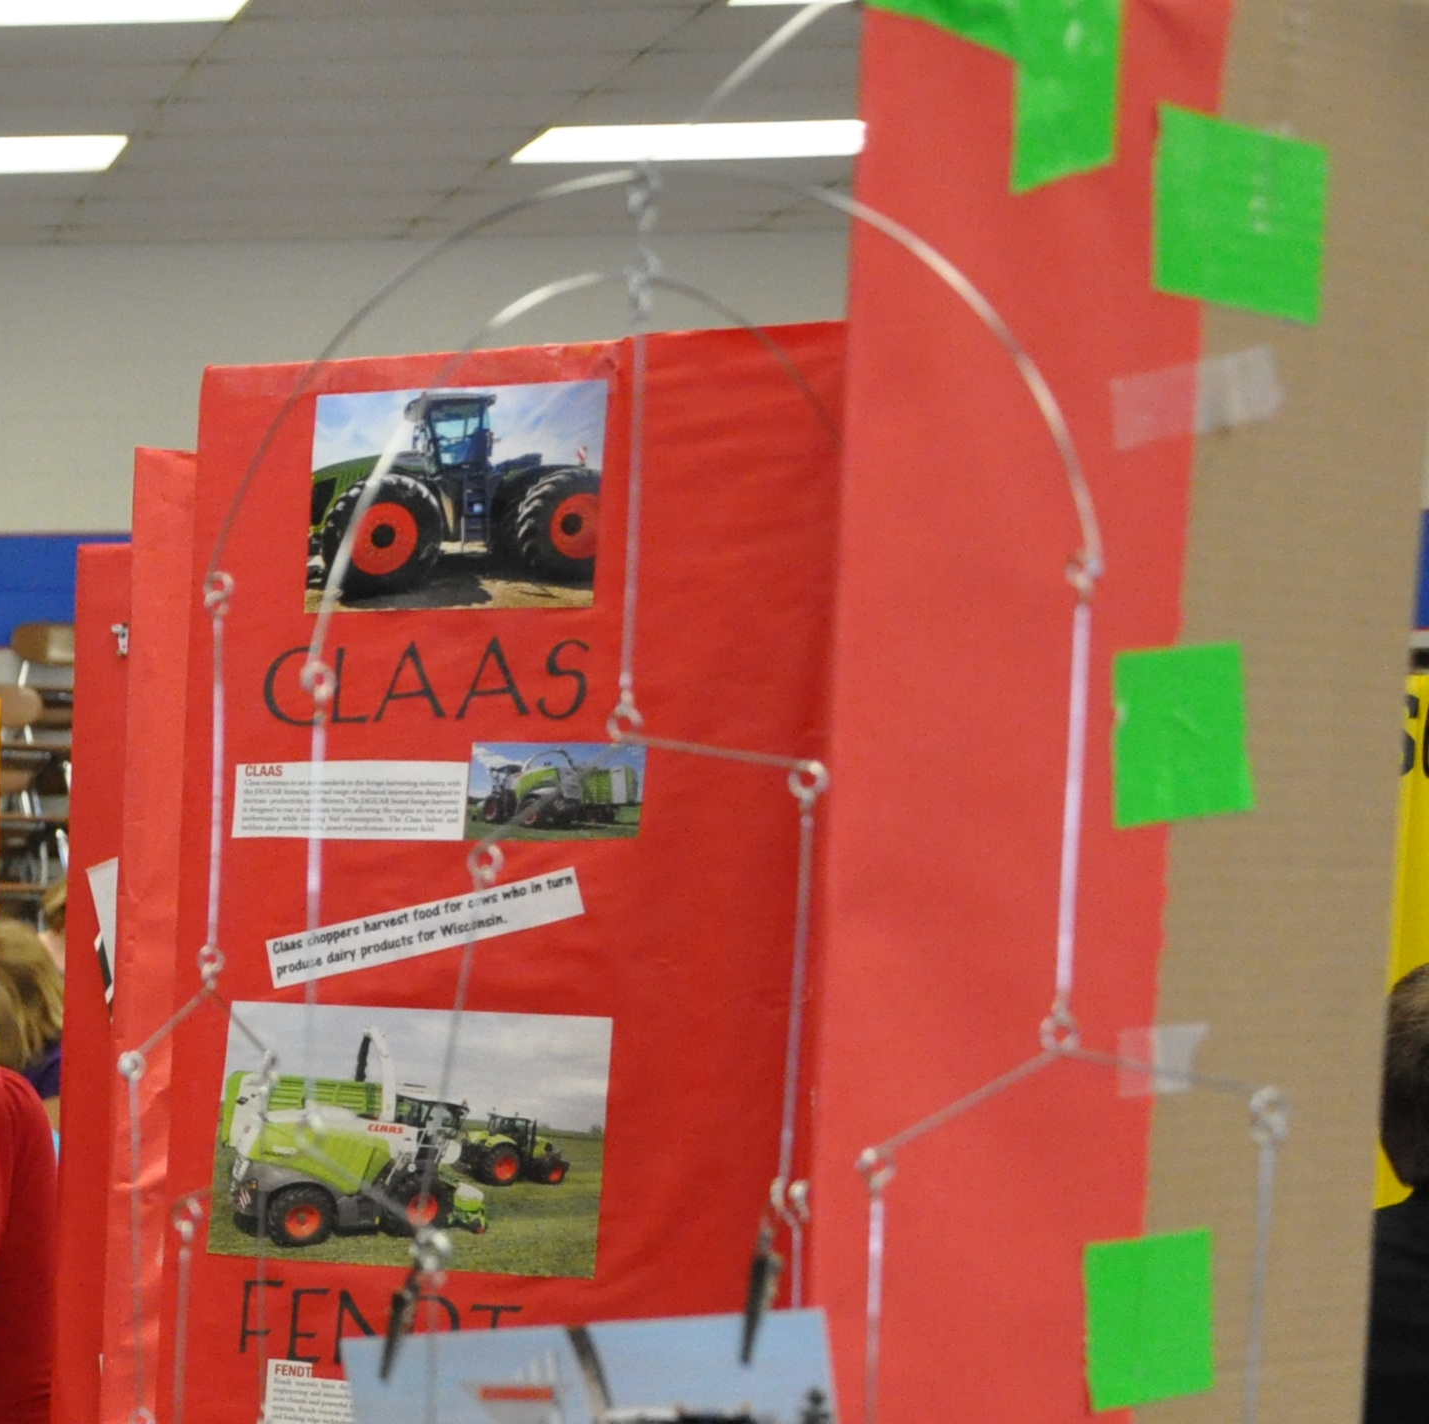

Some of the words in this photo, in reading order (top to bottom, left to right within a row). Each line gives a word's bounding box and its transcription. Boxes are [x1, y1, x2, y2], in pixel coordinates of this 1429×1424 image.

[263, 636, 590, 727] CLAAS
[245, 765, 283, 777] CLAAS
[272, 937, 303, 955] Claas
[307, 925, 360, 949] choppers
[364, 913, 409, 933] harvest
[413, 905, 441, 923] food
[444, 900, 464, 916] for
[502, 885, 527, 903] who
[530, 882, 542, 897] in
[547, 874, 573, 892] turn
[327, 948, 357, 967] dairy
[361, 935, 413, 959] products
[418, 929, 437, 945] for
[440, 913, 508, 938] Wisconsin.
[368, 1123, 404, 1135] CLAAS
[274, 1363, 312, 1379] FENDT
